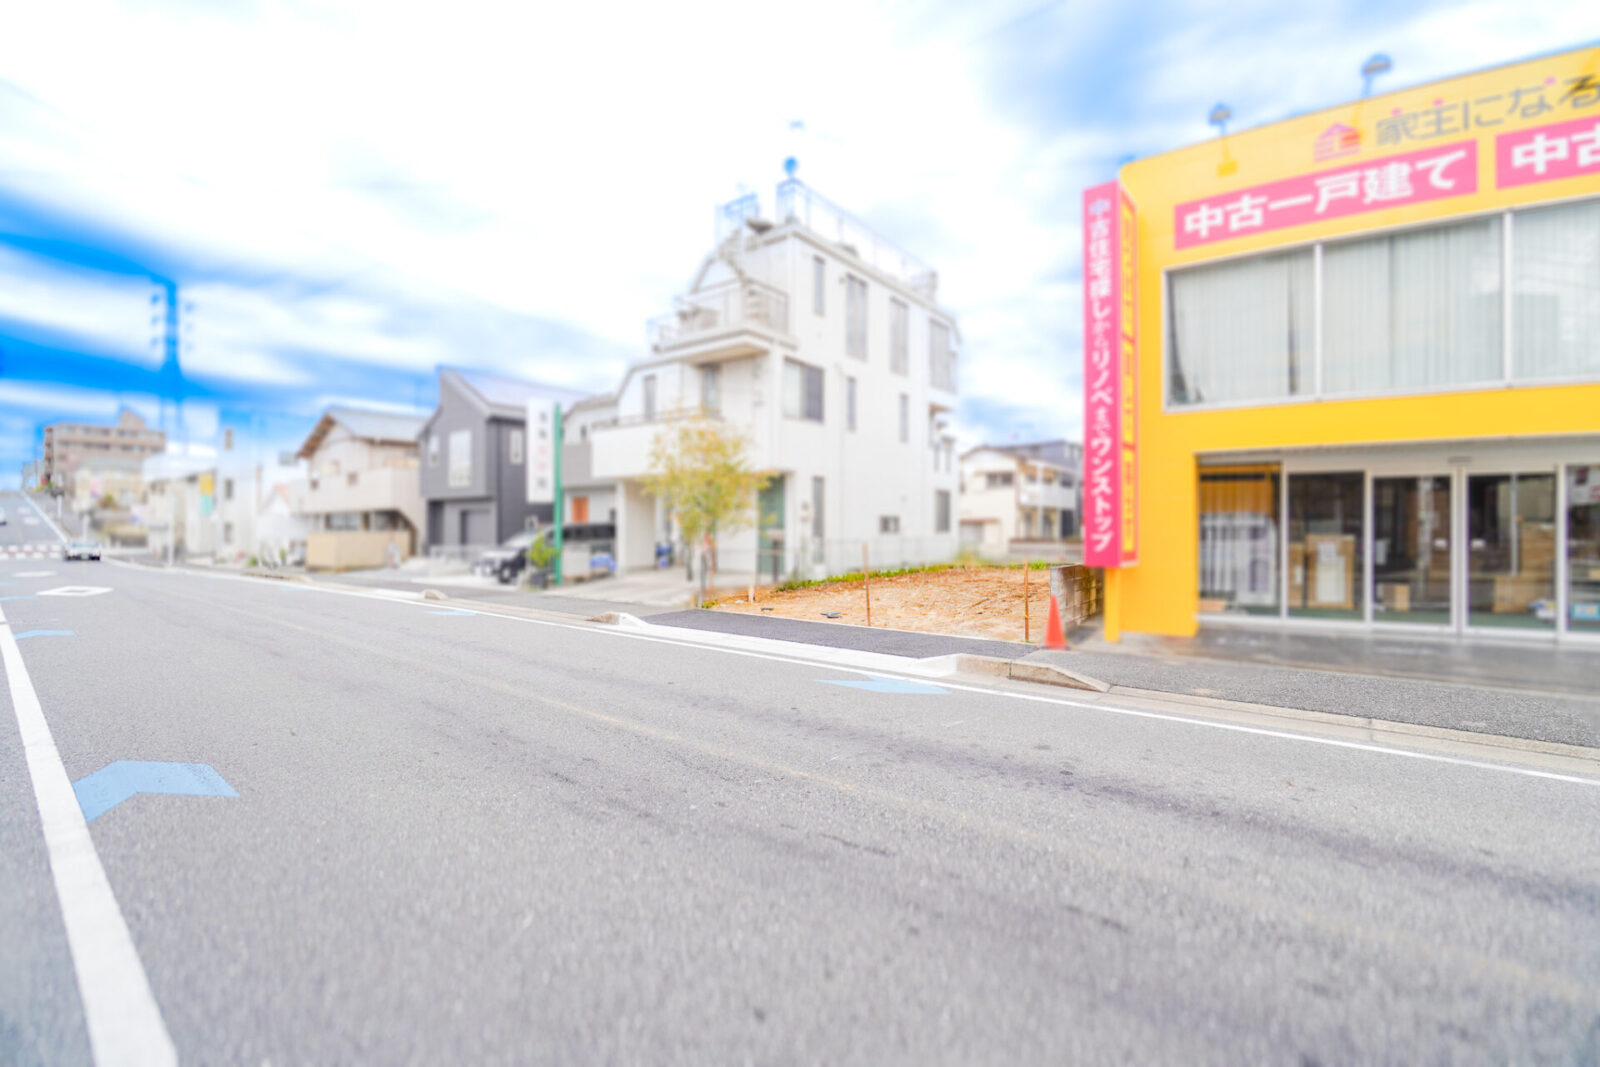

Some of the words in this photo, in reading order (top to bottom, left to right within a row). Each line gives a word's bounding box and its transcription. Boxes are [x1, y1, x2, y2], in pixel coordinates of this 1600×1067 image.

[1184, 149, 1467, 238] 中古一戸建て
